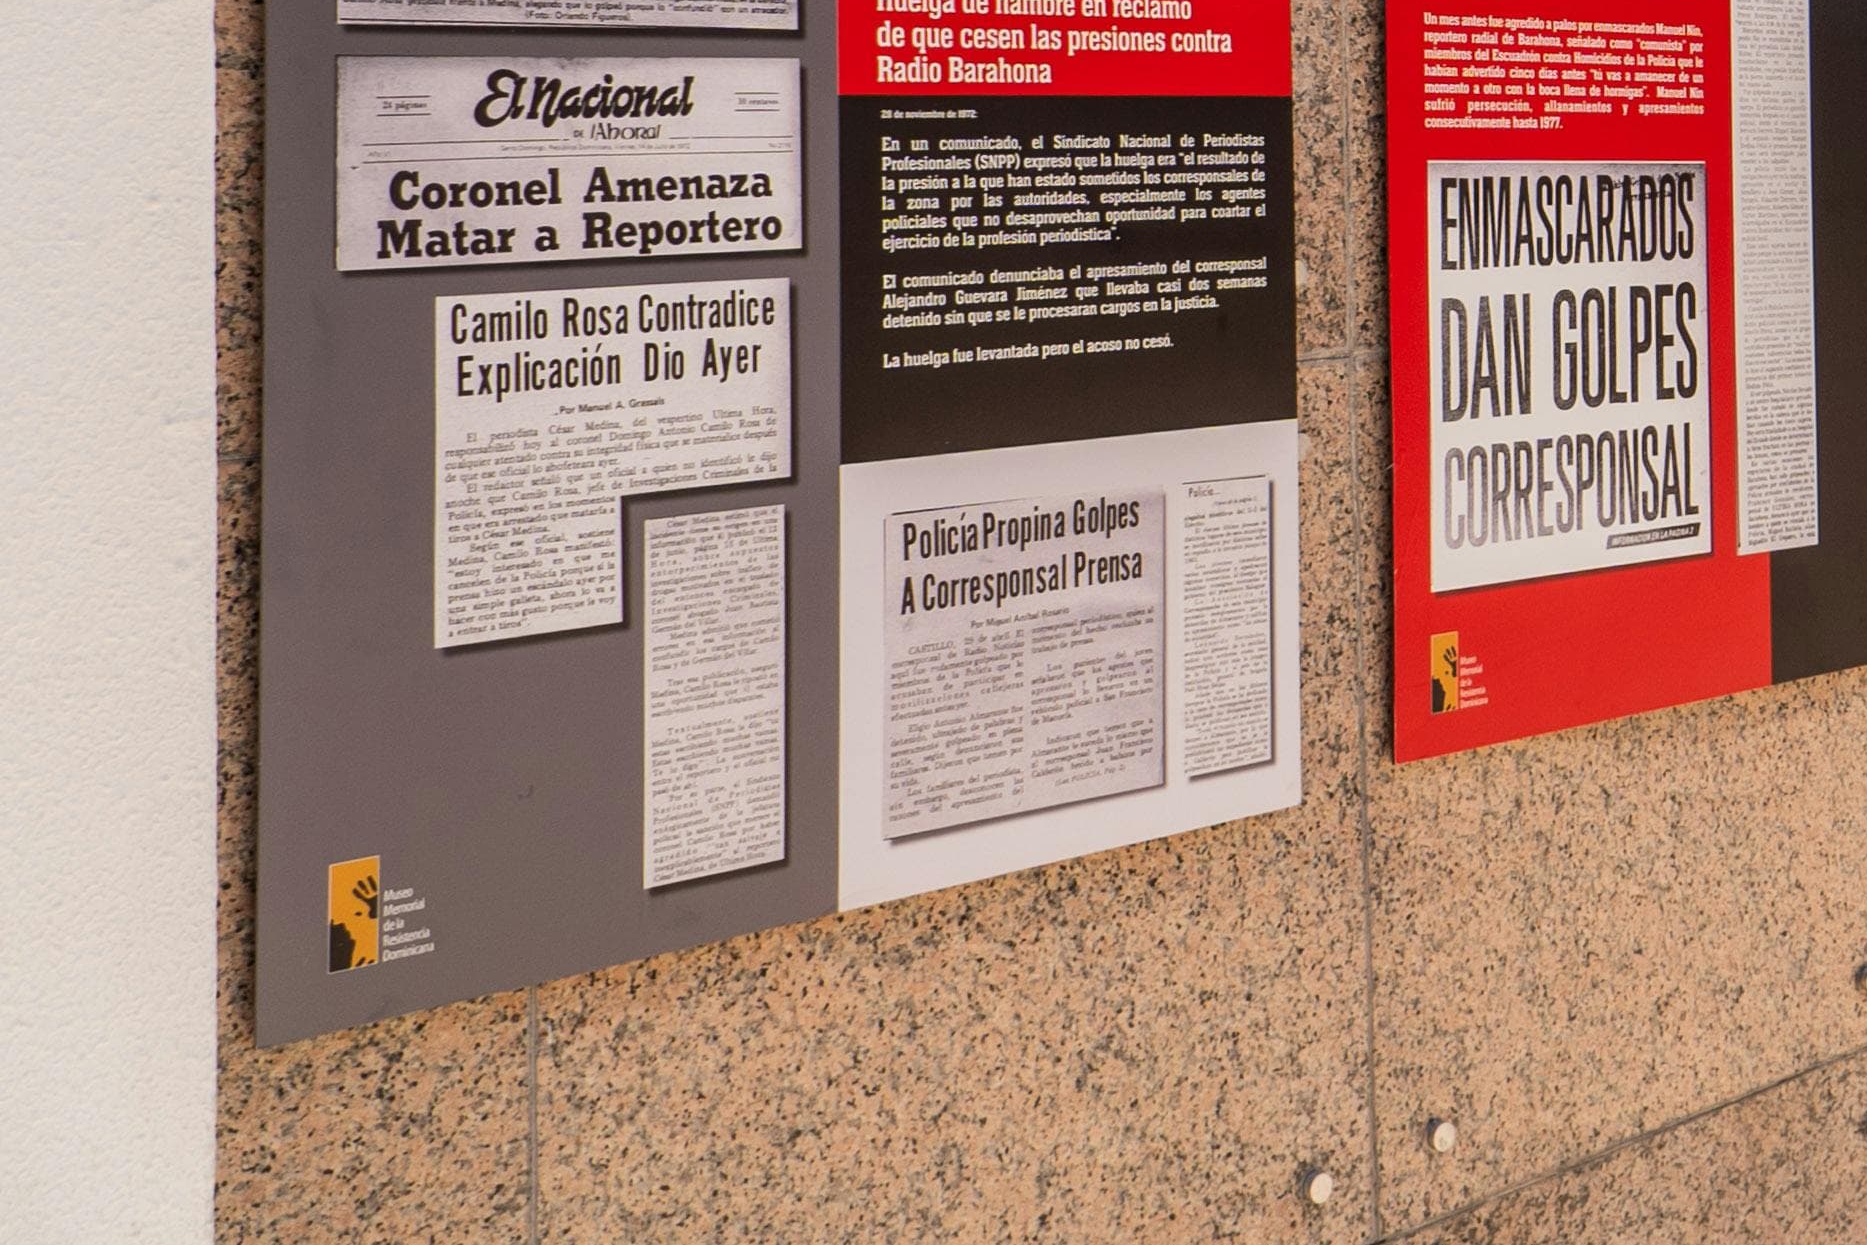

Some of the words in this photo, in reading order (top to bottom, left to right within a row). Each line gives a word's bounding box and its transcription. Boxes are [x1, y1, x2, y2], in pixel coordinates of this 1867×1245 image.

[876, 19, 905, 47] de
[911, 26, 953, 54] que
[959, 27, 1024, 49] cesen
[1030, 23, 1061, 50] las
[1067, 25, 1165, 56] presiones
[1170, 29, 1232, 52] contra
[876, 55, 941, 82] Radio
[948, 56, 1051, 83] Barahona
[474, 69, 528, 127] El
[527, 74, 694, 127] Nacional
[881, 136, 900, 151] En
[910, 139, 929, 150] un
[938, 135, 1022, 150] comunicado,
[1031, 134, 1043, 149] el
[1053, 134, 1110, 149] Sindicato
[1119, 133, 1171, 148] Nacional
[1179, 133, 1195, 147] de
[1203, 133, 1264, 147] Periodistas
[388, 167, 561, 210] Coronel
[583, 166, 772, 203] Amenaza
[376, 218, 515, 259] Matar
[534, 225, 559, 251] a
[582, 210, 781, 254] Reportero
[1441, 173, 1695, 270] ENMASCARADOS
[450, 299, 547, 344] Camilo
[562, 297, 627, 337] Rosa
[638, 289, 774, 333] Contradice
[457, 342, 620, 403] Explicación
[644, 341, 683, 381] Dio
[701, 337, 761, 382] Ayer
[882, 353, 900, 368] La
[903, 350, 949, 368] huelga
[952, 347, 973, 363] fue
[976, 342, 1039, 361] levantada
[1041, 343, 1069, 359] pero
[1071, 339, 1084, 354] el
[1086, 339, 1122, 352] acoso
[1124, 338, 1140, 349] no
[1142, 332, 1173, 348] cesó.
[1442, 293, 1532, 423] DAN
[1553, 282, 1697, 410] GOLPES
[1445, 422, 1699, 550] CORRESPONSAL
[903, 512, 977, 560] Policía
[982, 505, 1064, 551] Propina
[1072, 496, 1139, 539] Golpes
[900, 576, 915, 615] A
[922, 553, 1066, 611] Corresponsal
[1074, 551, 1141, 587] Prensa
